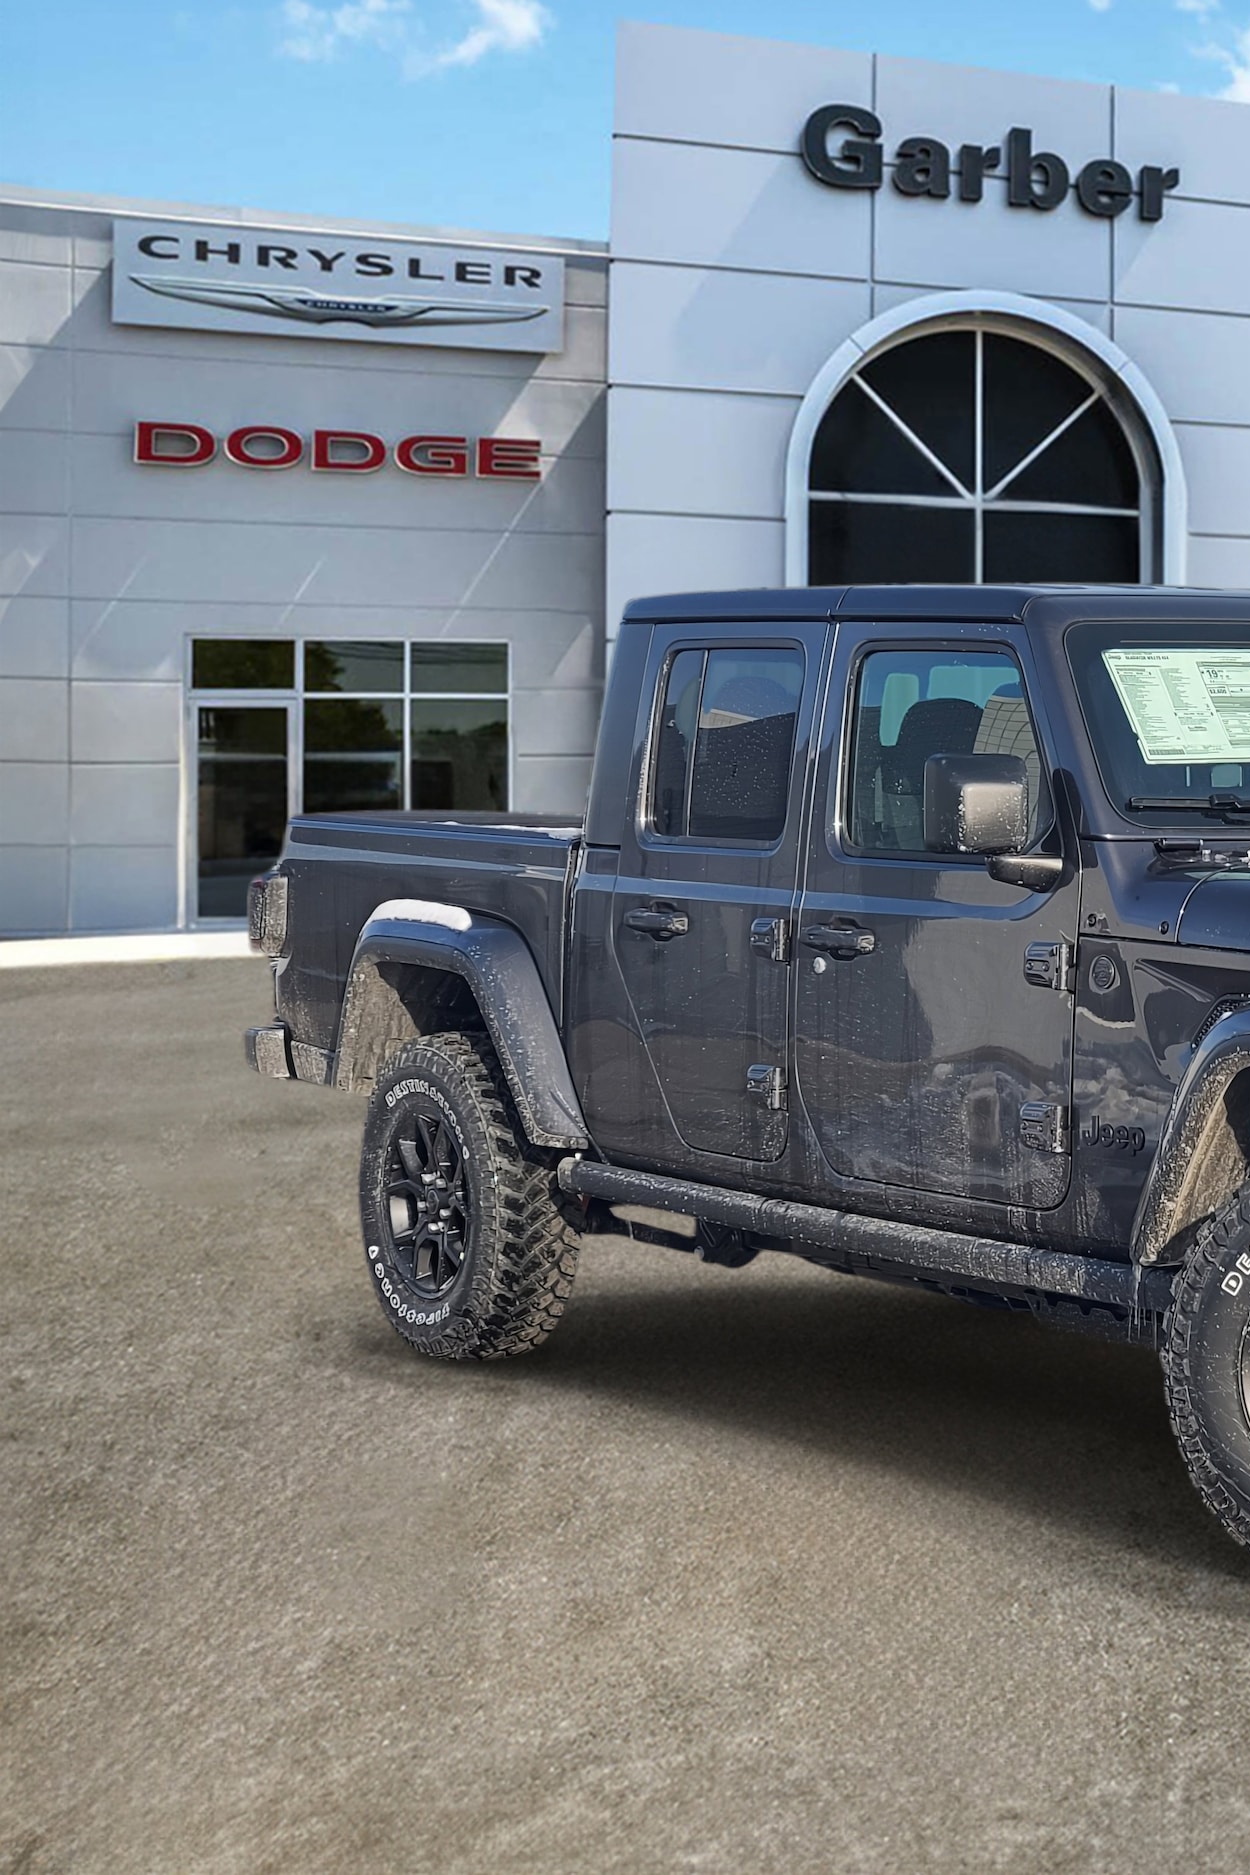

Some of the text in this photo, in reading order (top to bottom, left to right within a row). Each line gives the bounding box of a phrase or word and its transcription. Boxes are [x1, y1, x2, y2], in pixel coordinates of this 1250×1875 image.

[801, 104, 1180, 222] Garber
[137, 235, 543, 289] CHRYSLER
[306, 300, 386, 313] CHRYSLER
[134, 421, 542, 480] DODGE
[1206, 669, 1219, 679] 19
[1081, 1115, 1146, 1157] Jeep
